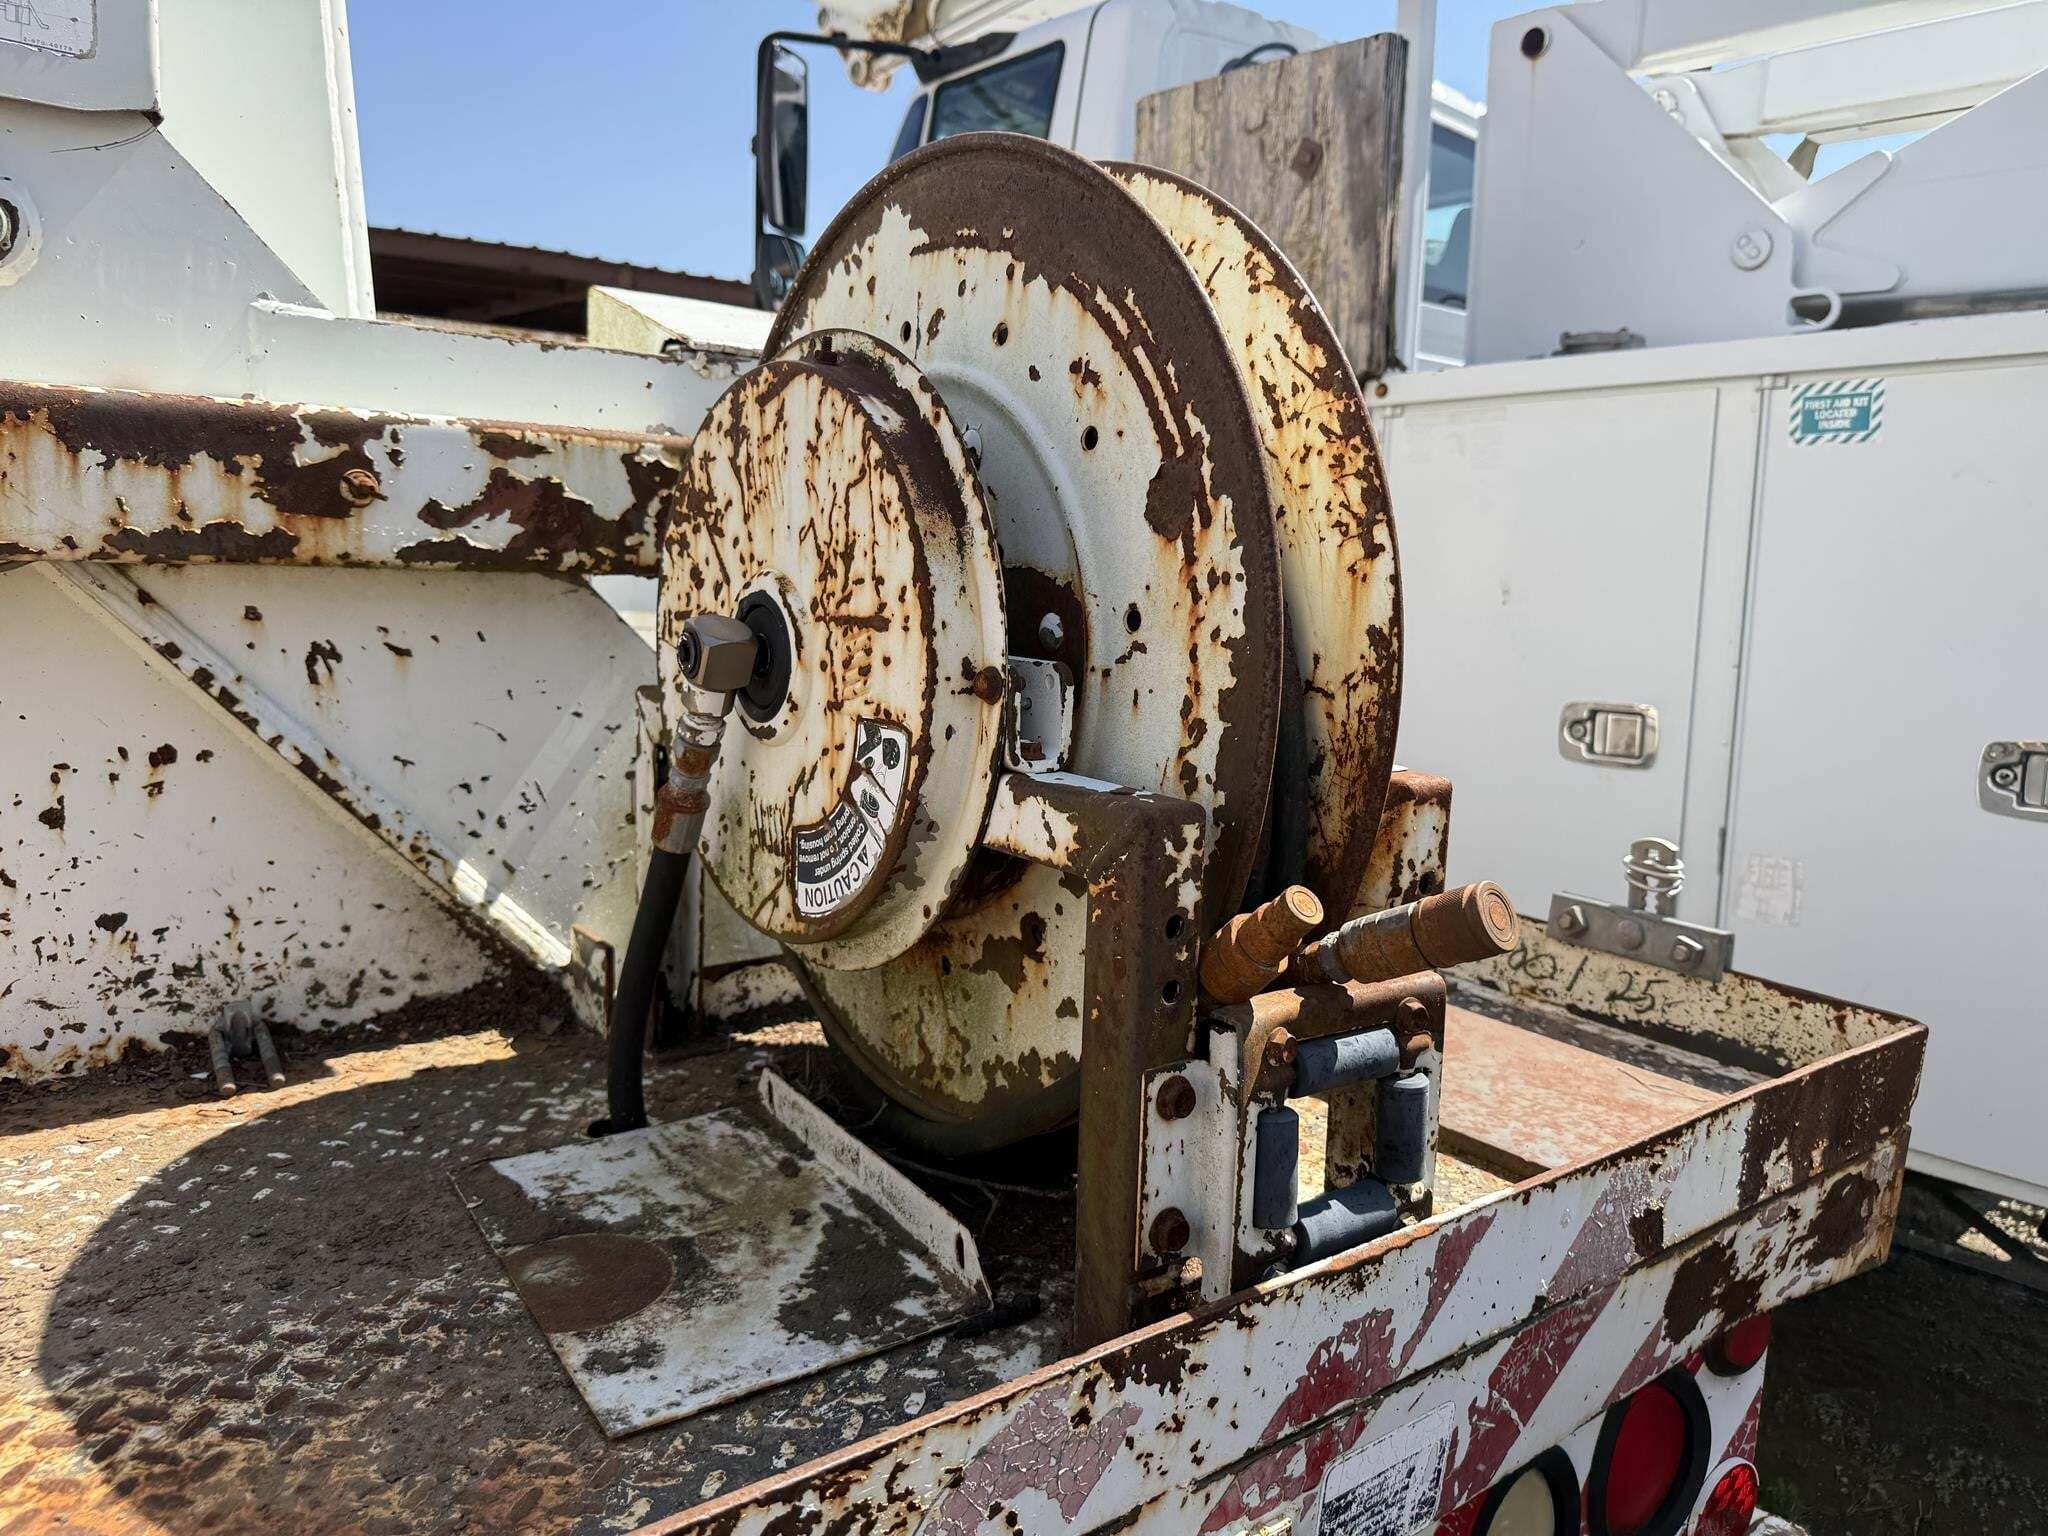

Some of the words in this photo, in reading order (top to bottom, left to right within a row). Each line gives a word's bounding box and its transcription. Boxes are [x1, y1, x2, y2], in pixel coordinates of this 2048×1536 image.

[847, 822, 865, 852] Coiled
[799, 854, 820, 863] remove
[830, 846, 849, 869] spring
[815, 863, 831, 877] under
[805, 861, 861, 908] CAUTION
